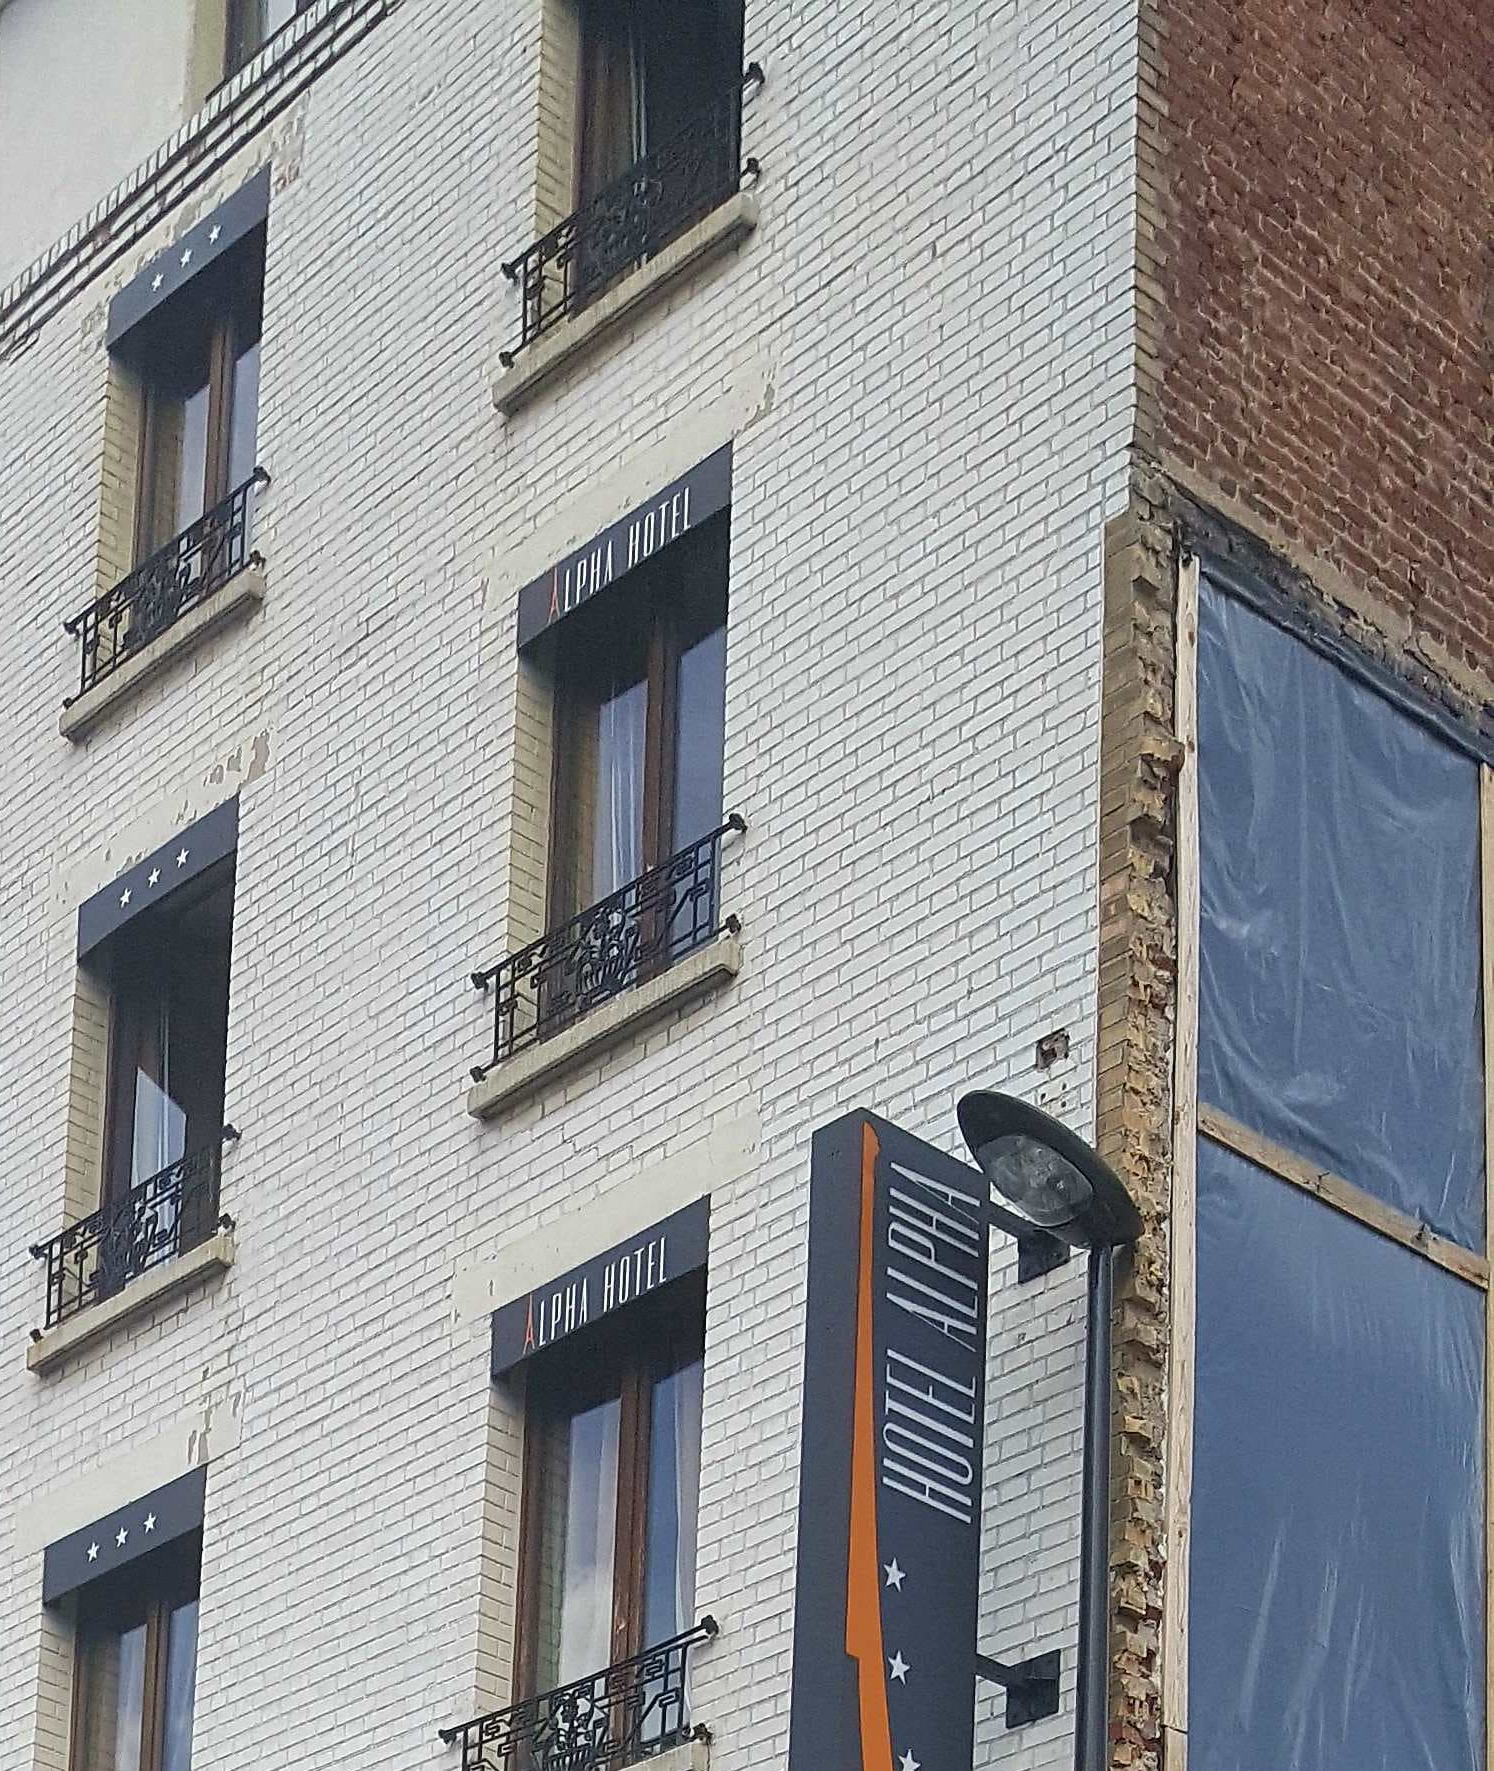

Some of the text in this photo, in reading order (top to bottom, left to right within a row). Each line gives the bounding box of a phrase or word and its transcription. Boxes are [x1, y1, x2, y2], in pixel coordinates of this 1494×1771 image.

[547, 487, 692, 626] ALPHA HOTEL
[522, 1236, 668, 1356] ALPHA HOTEL
[882, 1161, 981, 1524] HOTEL ALPHA
